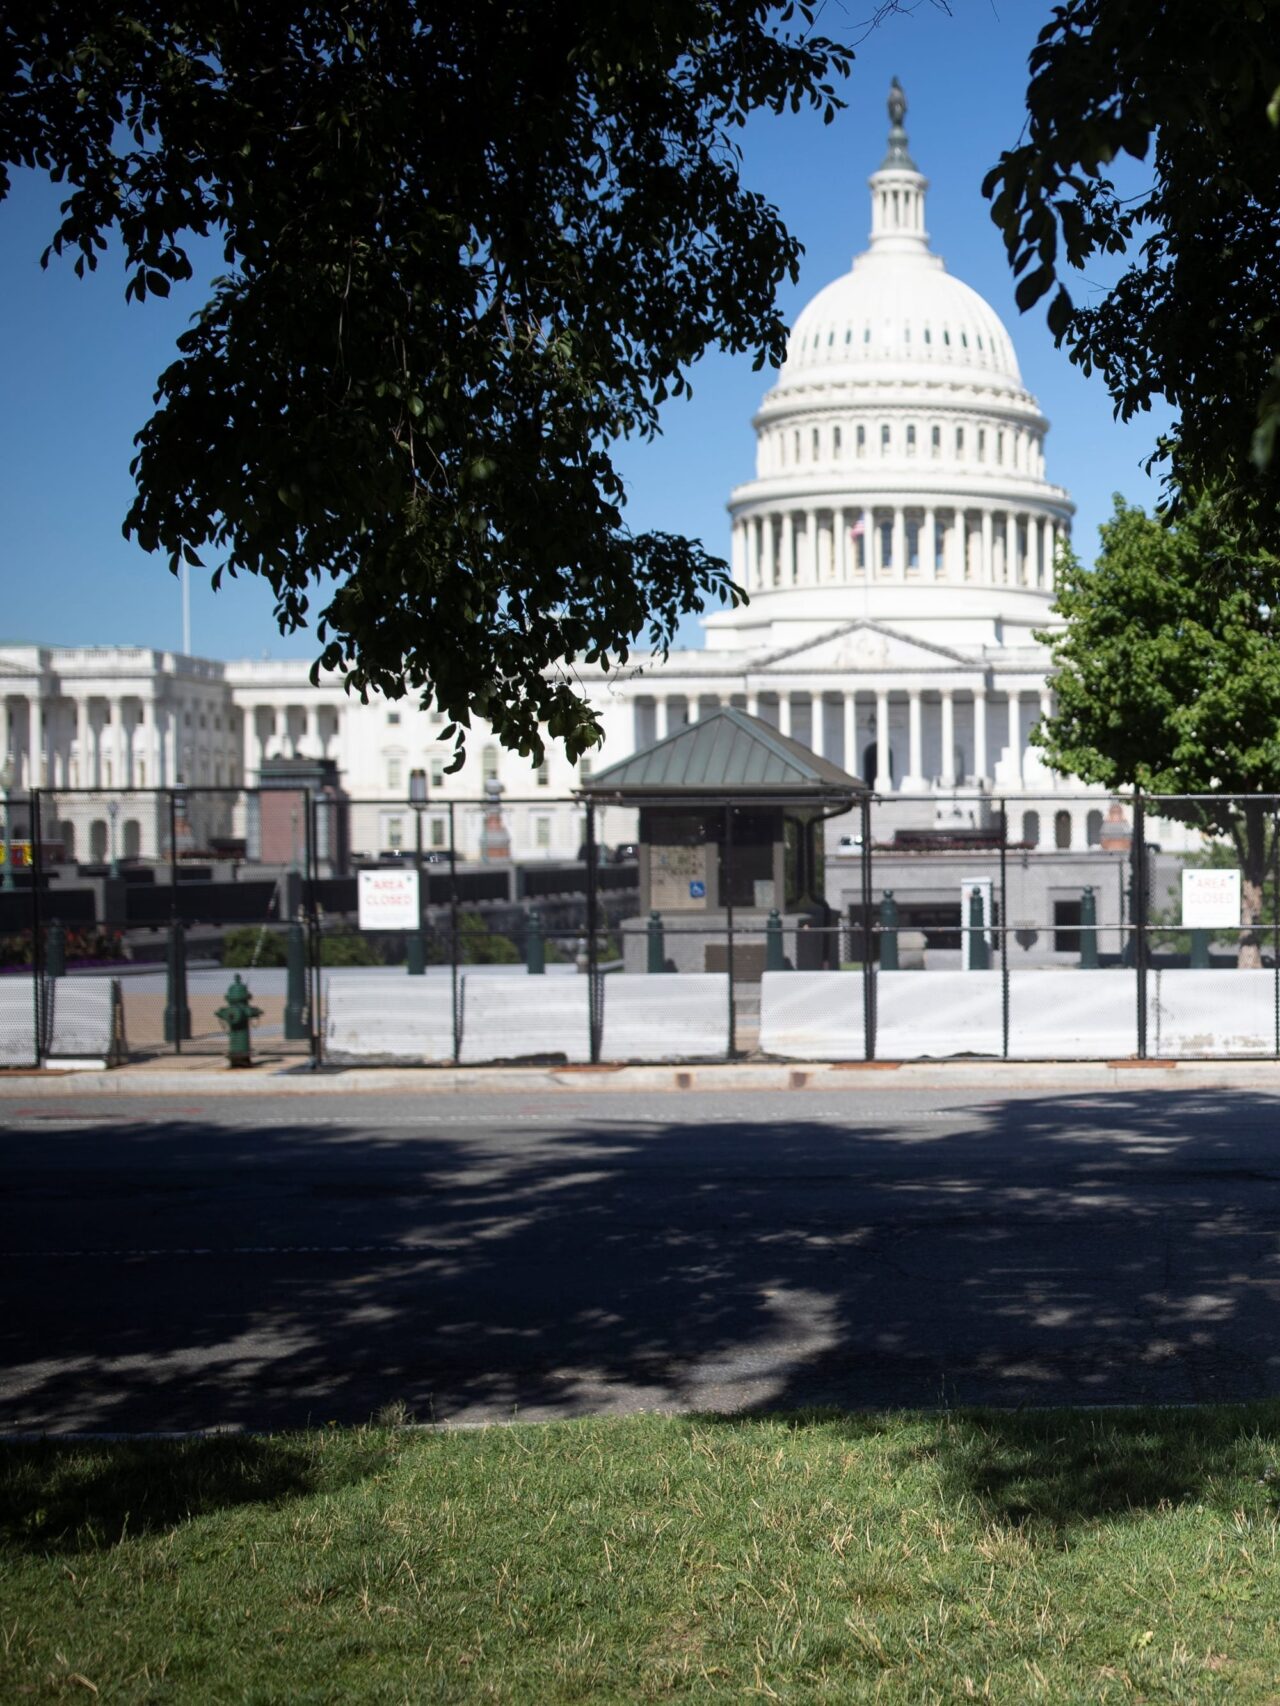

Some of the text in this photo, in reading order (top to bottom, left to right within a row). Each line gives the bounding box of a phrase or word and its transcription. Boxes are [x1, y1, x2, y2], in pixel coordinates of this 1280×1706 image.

[373, 880, 404, 890] AREA
[1197, 879, 1227, 888] AREA
[366, 895, 412, 906] CLOSED
[1189, 892, 1233, 904] CLOSED
